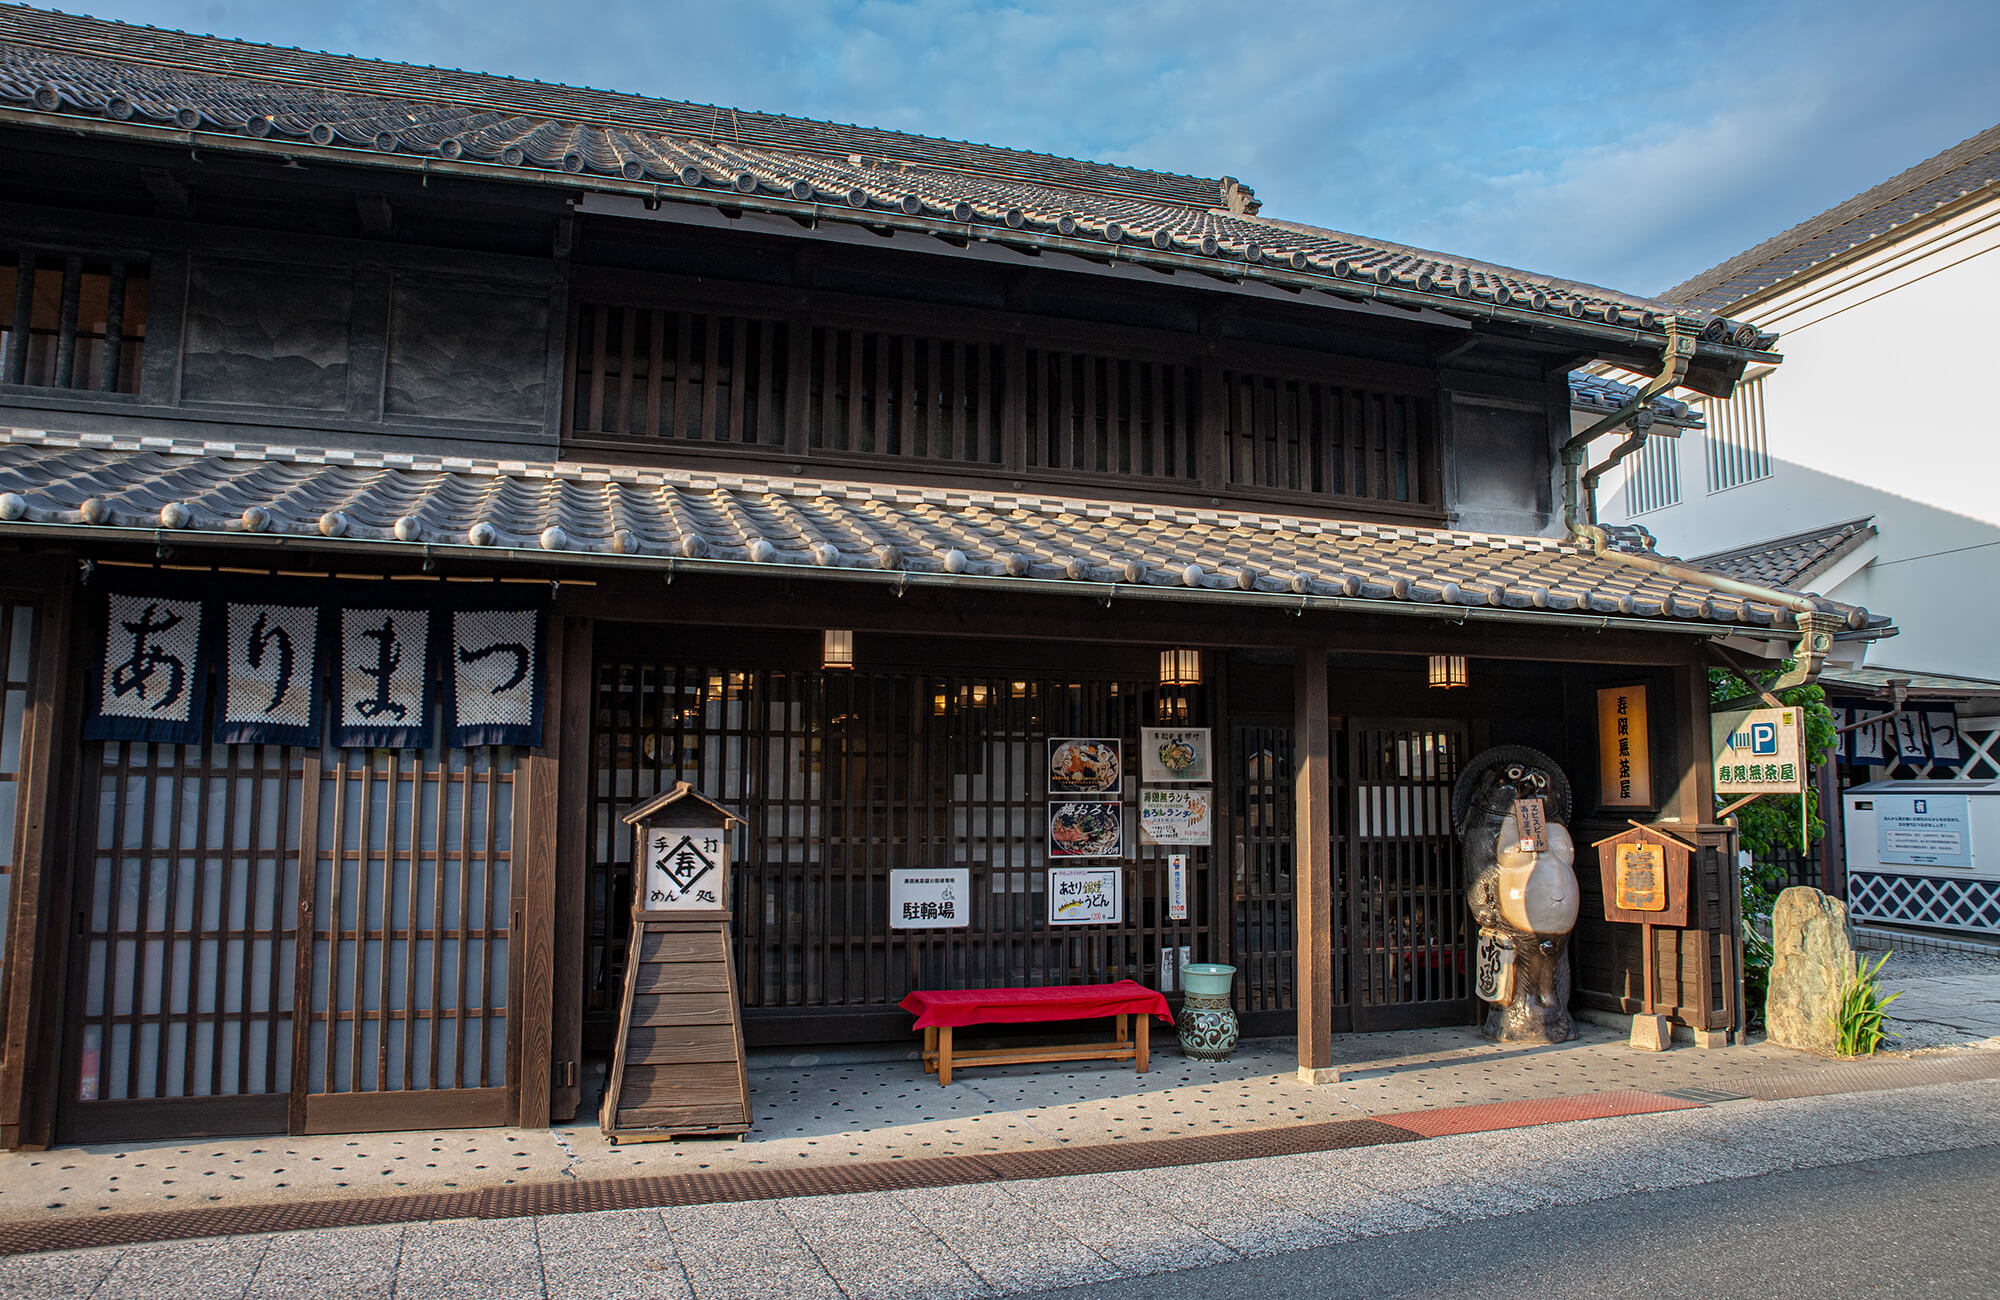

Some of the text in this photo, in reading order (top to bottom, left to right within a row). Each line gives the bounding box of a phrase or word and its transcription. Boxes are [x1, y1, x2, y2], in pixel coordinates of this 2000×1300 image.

[1754, 726, 1774, 752] P
[1718, 762, 1796, 782] 寿限無茶屋
[903, 901, 955, 920] 駐輪場
